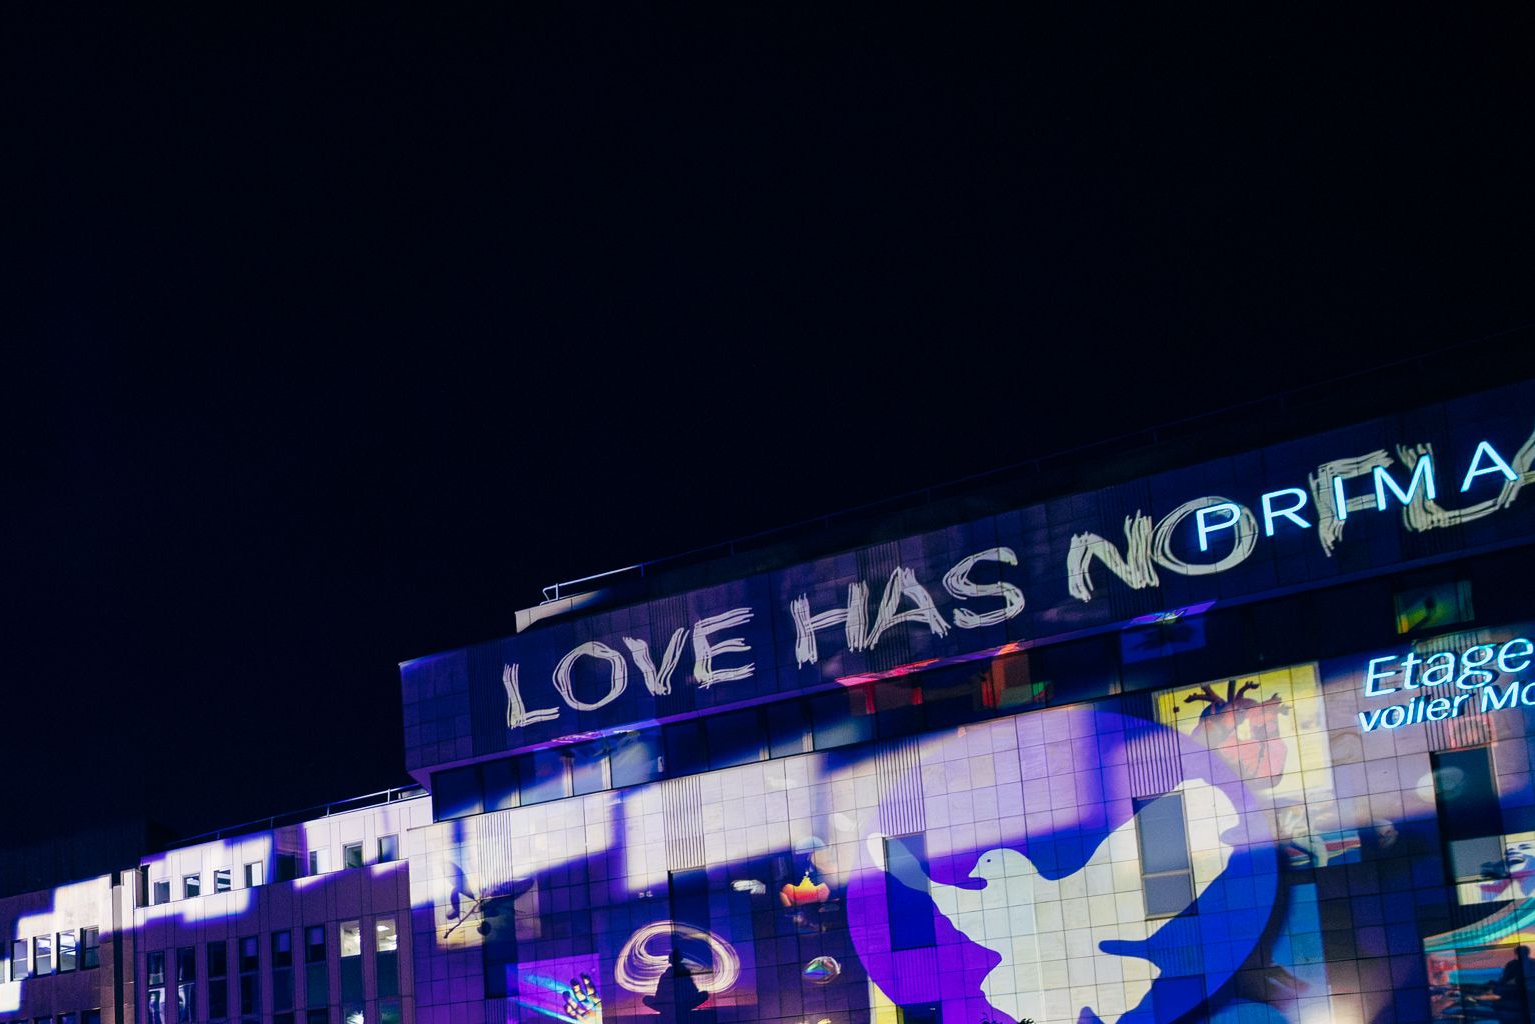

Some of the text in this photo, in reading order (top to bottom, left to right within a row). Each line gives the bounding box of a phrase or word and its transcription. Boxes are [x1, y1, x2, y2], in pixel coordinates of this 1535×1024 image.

[1196, 440, 1518, 552] PRIMA
[503, 606, 755, 729] LOVE
[790, 546, 1025, 669] HAS
[1066, 496, 1258, 602] NO
[1364, 637, 1535, 698] Etage
